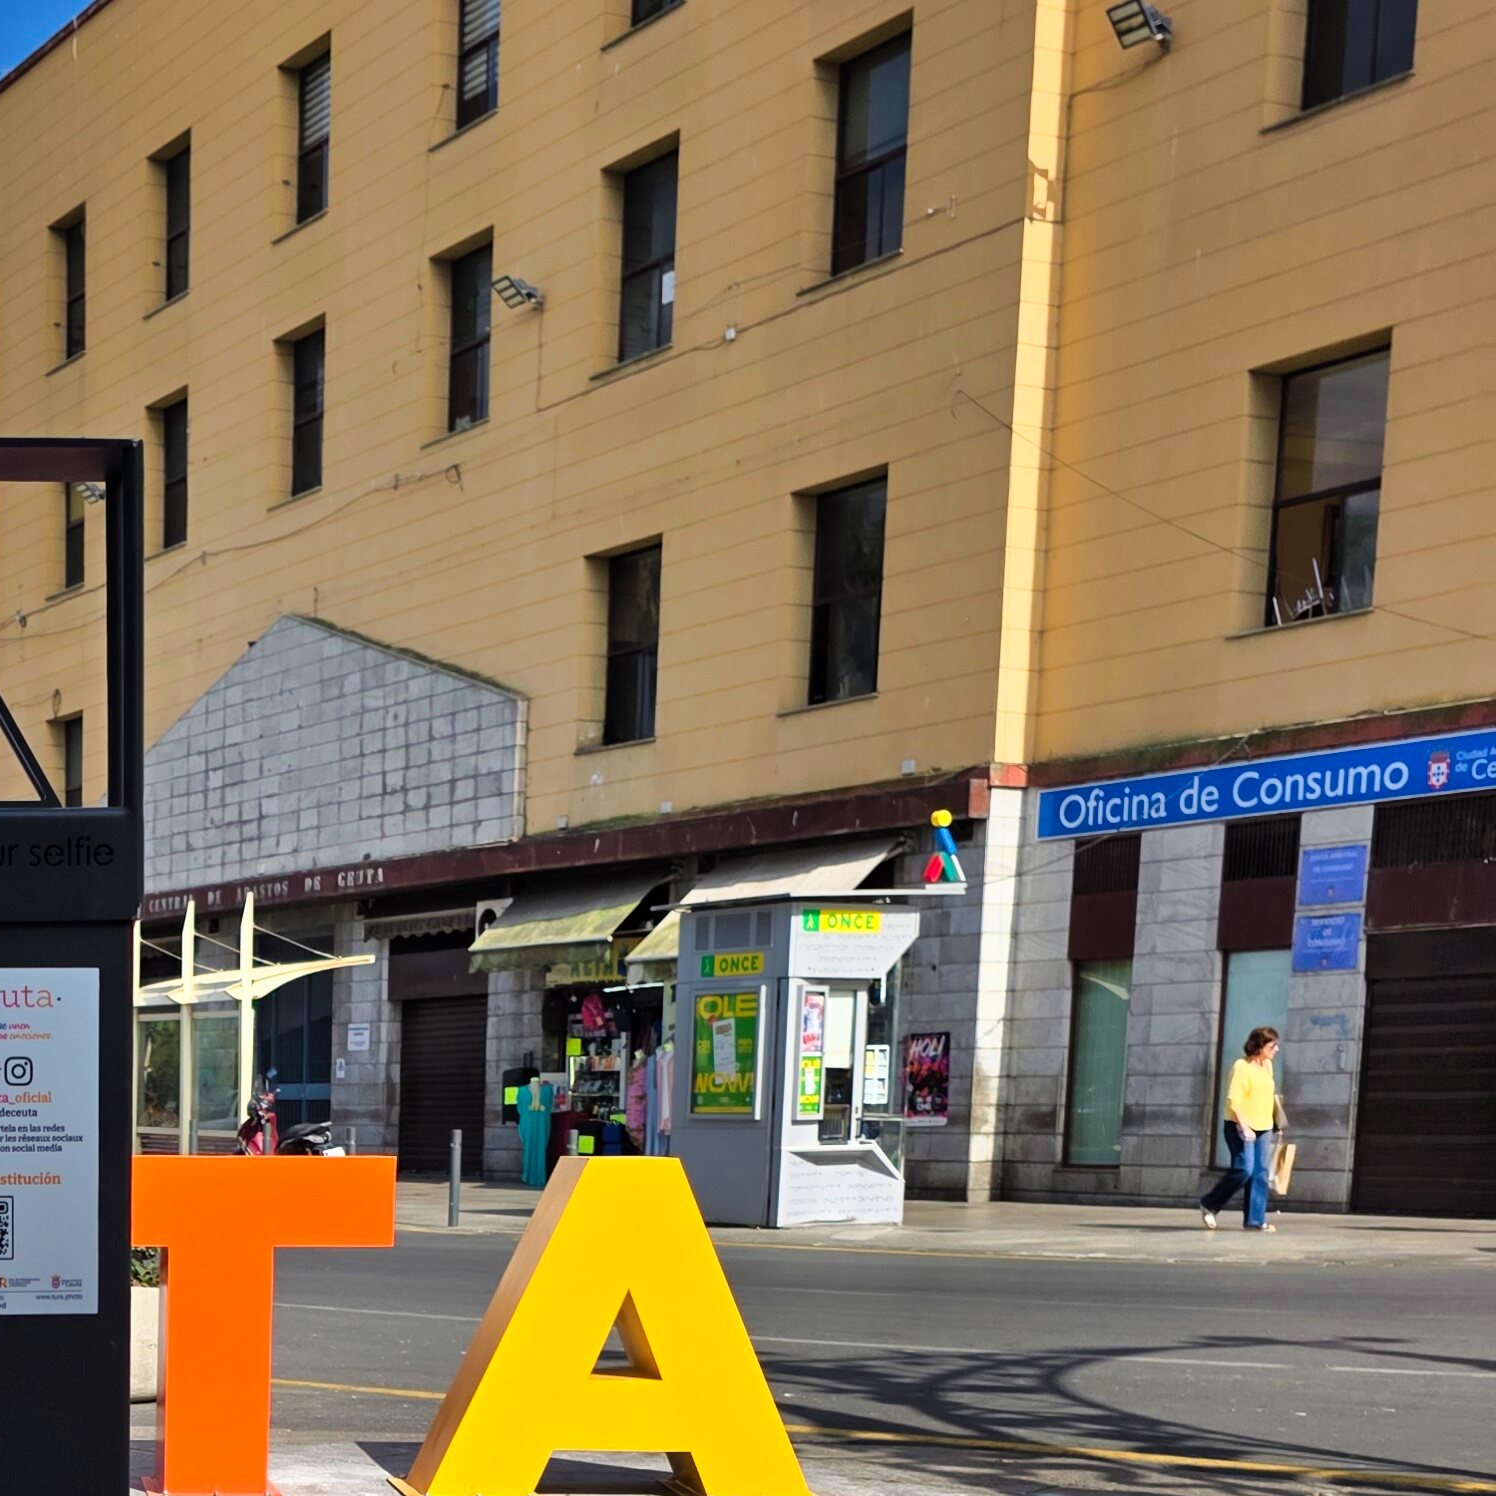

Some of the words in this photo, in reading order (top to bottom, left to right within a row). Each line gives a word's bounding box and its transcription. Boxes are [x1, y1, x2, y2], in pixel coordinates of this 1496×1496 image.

[1059, 787, 1167, 829] Oficina
[1180, 776, 1220, 816] de
[1232, 760, 1410, 808] Consumo
[28, 836, 115, 867] selfie
[305, 875, 322, 892] DE
[337, 866, 385, 888] CEUTA
[826, 911, 875, 930] ONCE
[719, 955, 760, 973] ONCE
[17, 1125, 29, 1133] en
[29, 1123, 42, 1133] las
[42, 1123, 66, 1133] redes
[4, 1133, 17, 1143] les
[51, 1133, 84, 1143] sociaux
[0, 1145, 11, 1153] on
[11, 1143, 36, 1153] social
[36, 1143, 63, 1153] media
